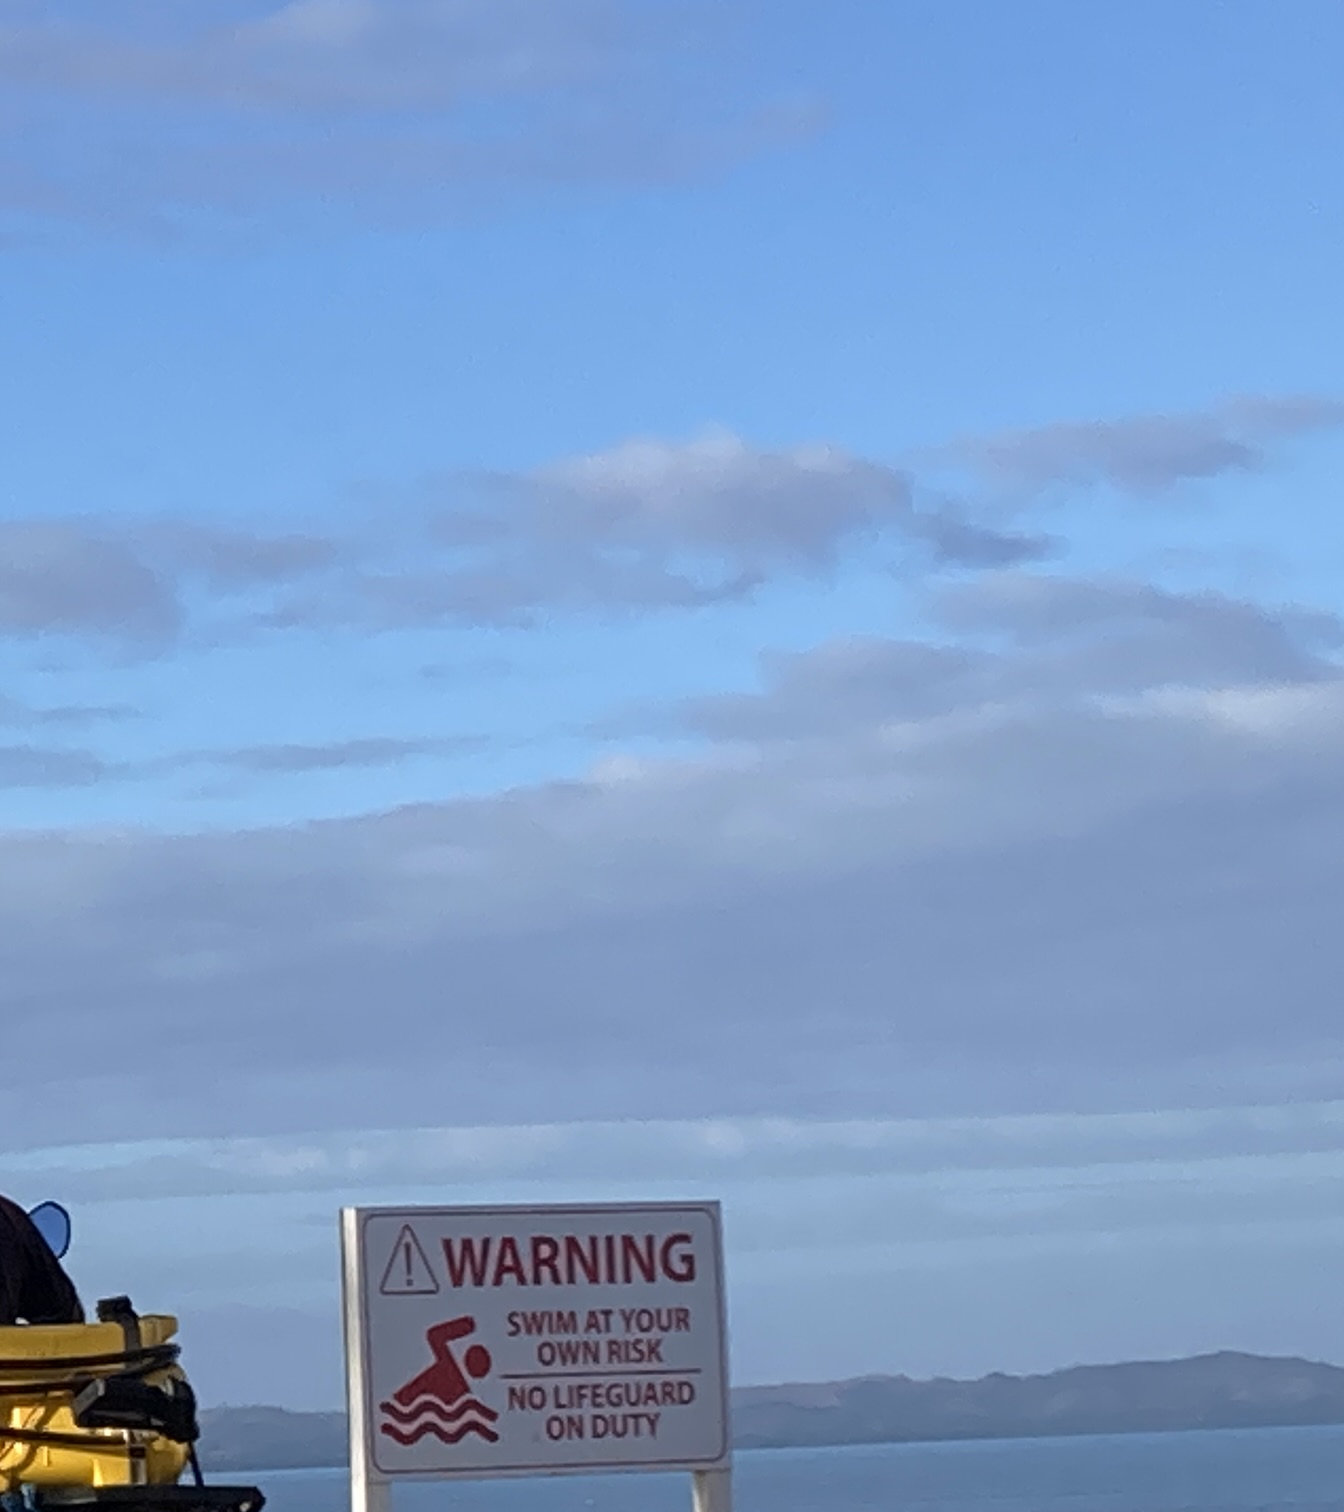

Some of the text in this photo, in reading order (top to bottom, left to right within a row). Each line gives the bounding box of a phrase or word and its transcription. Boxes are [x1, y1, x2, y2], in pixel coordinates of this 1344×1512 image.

[442, 1233, 695, 1288] WARNING
[507, 1308, 691, 1337] SWIM AT YOUR
[537, 1338, 663, 1367] OWN RISK
[508, 1380, 695, 1411] NO LIFEGUARD
[546, 1413, 660, 1441] ON DUTY
